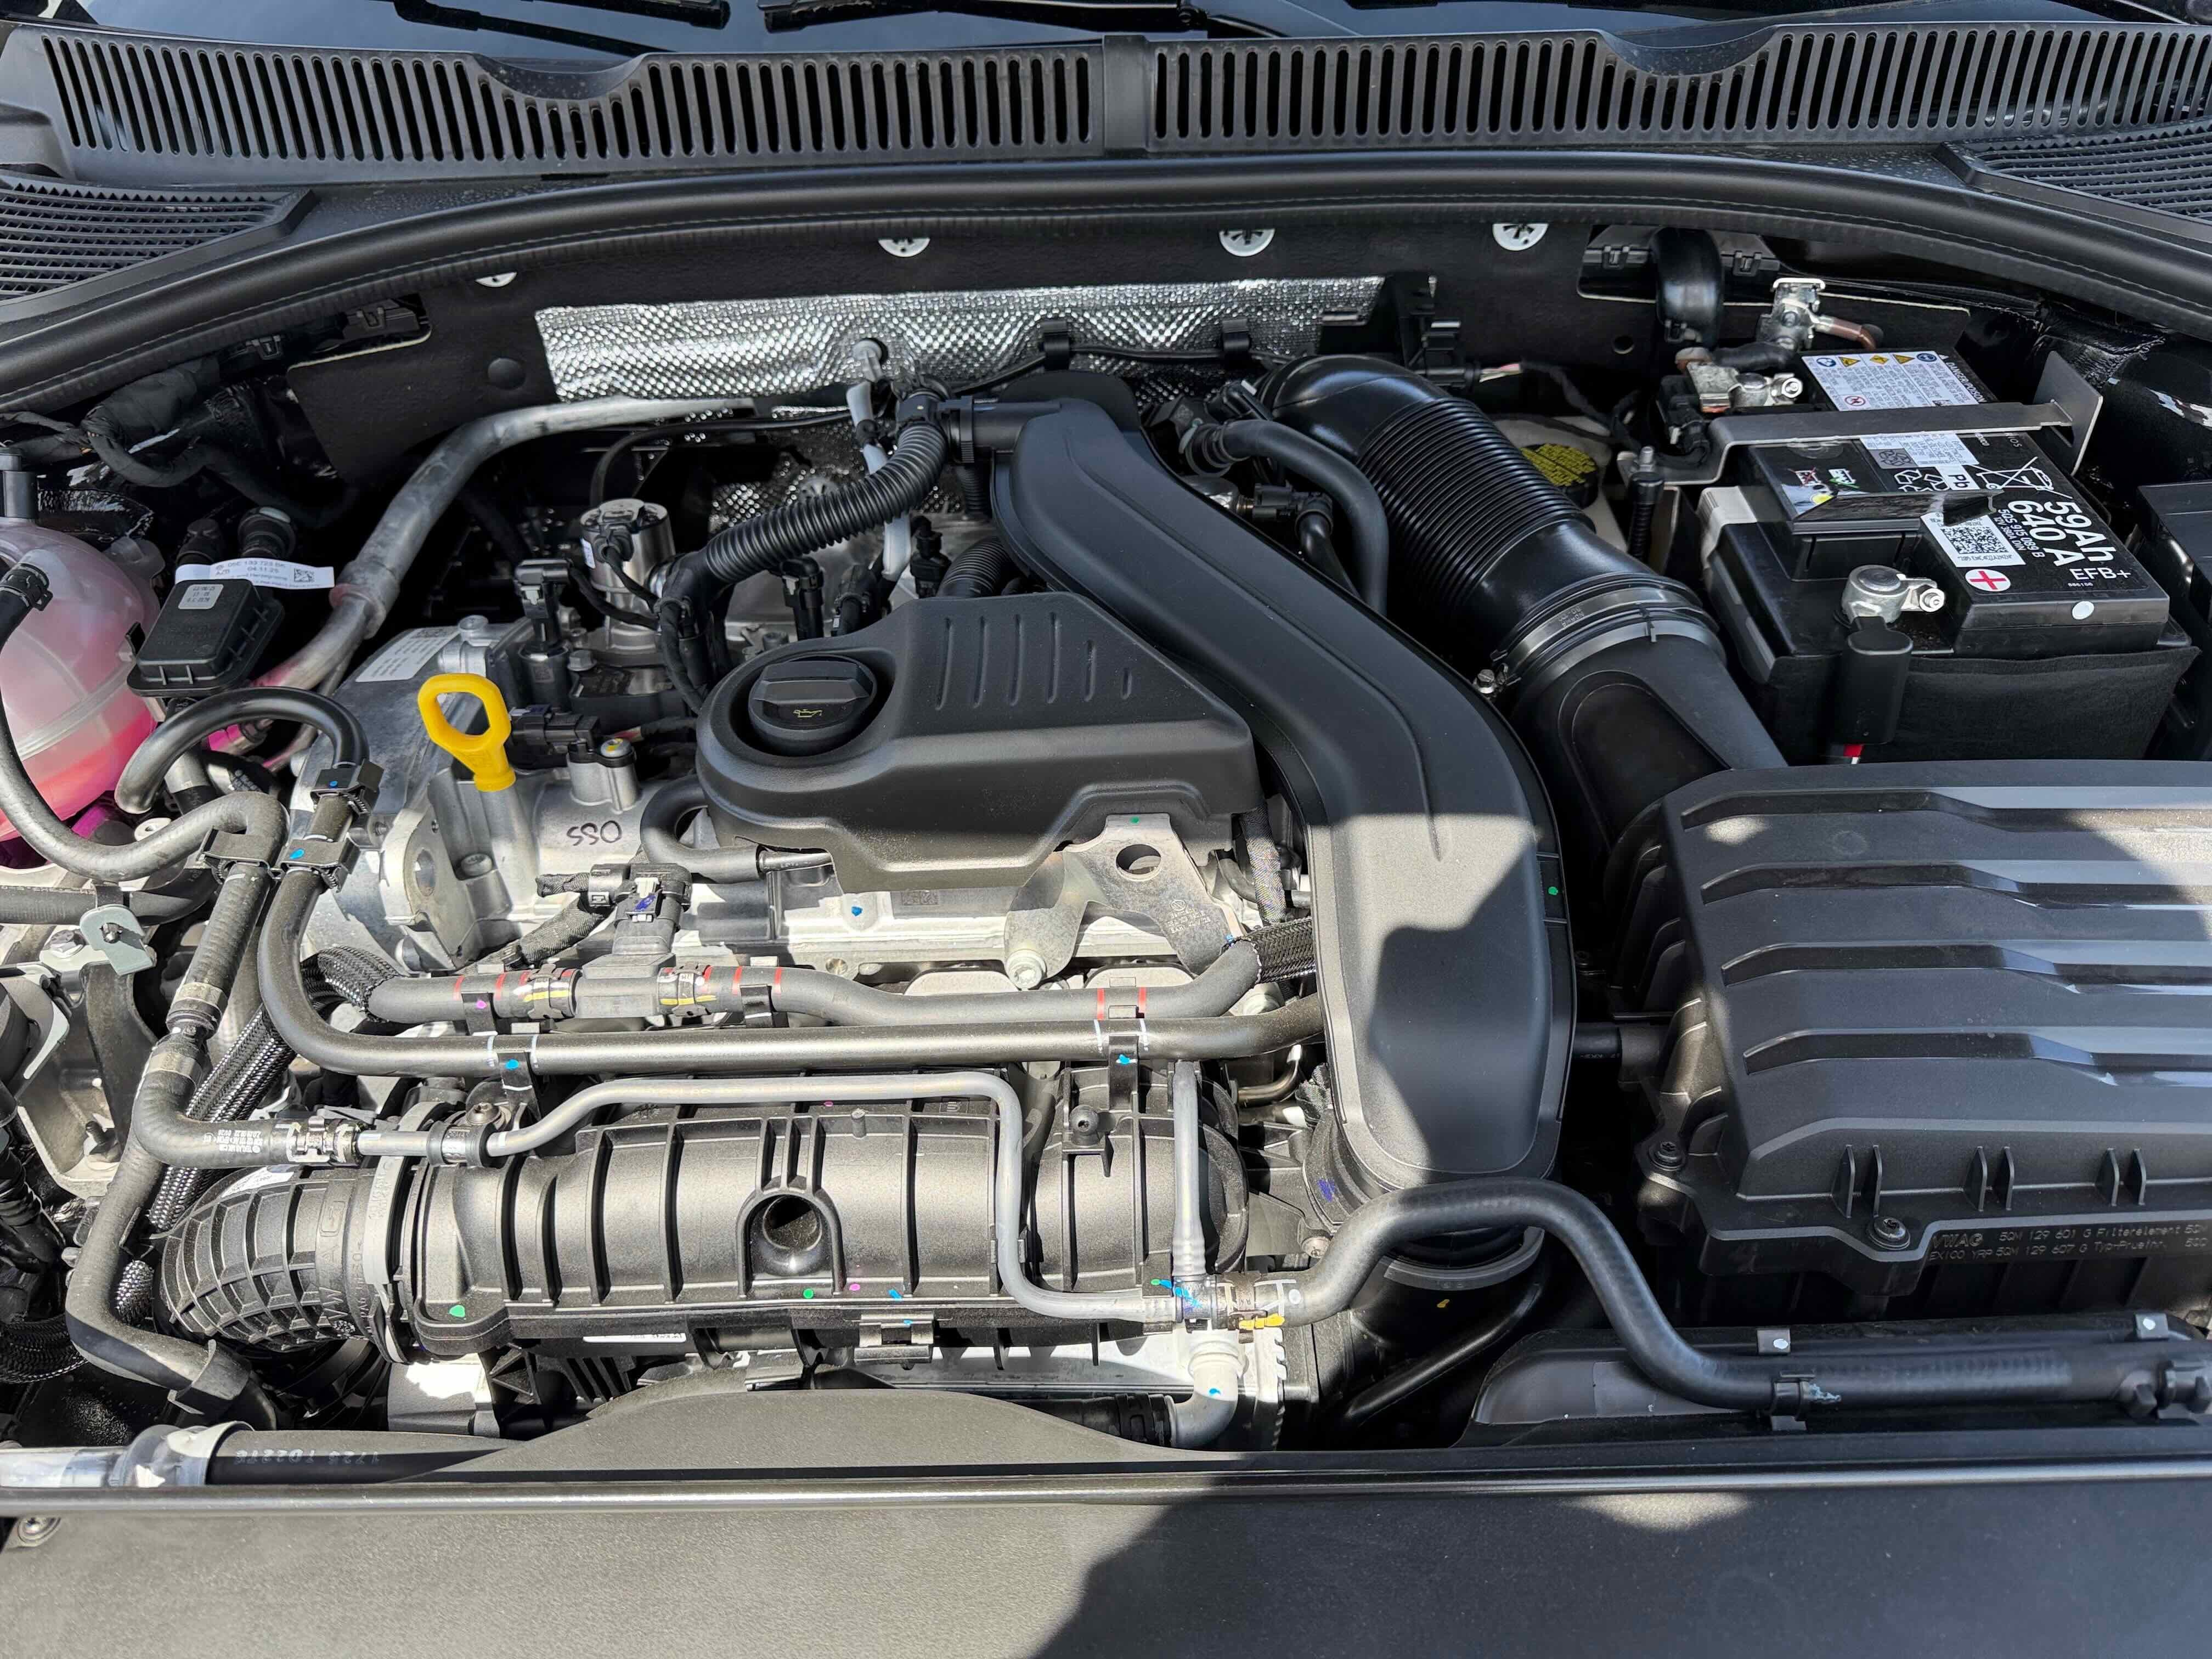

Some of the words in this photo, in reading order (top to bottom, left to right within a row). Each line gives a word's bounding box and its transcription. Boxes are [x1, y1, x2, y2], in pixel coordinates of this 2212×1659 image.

[1947, 362, 1987, 403] DANGER/POISON
[1948, 473, 1969, 490] Pb
[2008, 500, 2067, 541] 640
[2042, 548, 2085, 567] A
[2010, 524, 2028, 537] 915
[2044, 501, 2117, 562] 59Ah
[2011, 539, 2027, 551] DIN
[2069, 567, 2131, 580] EFB+
